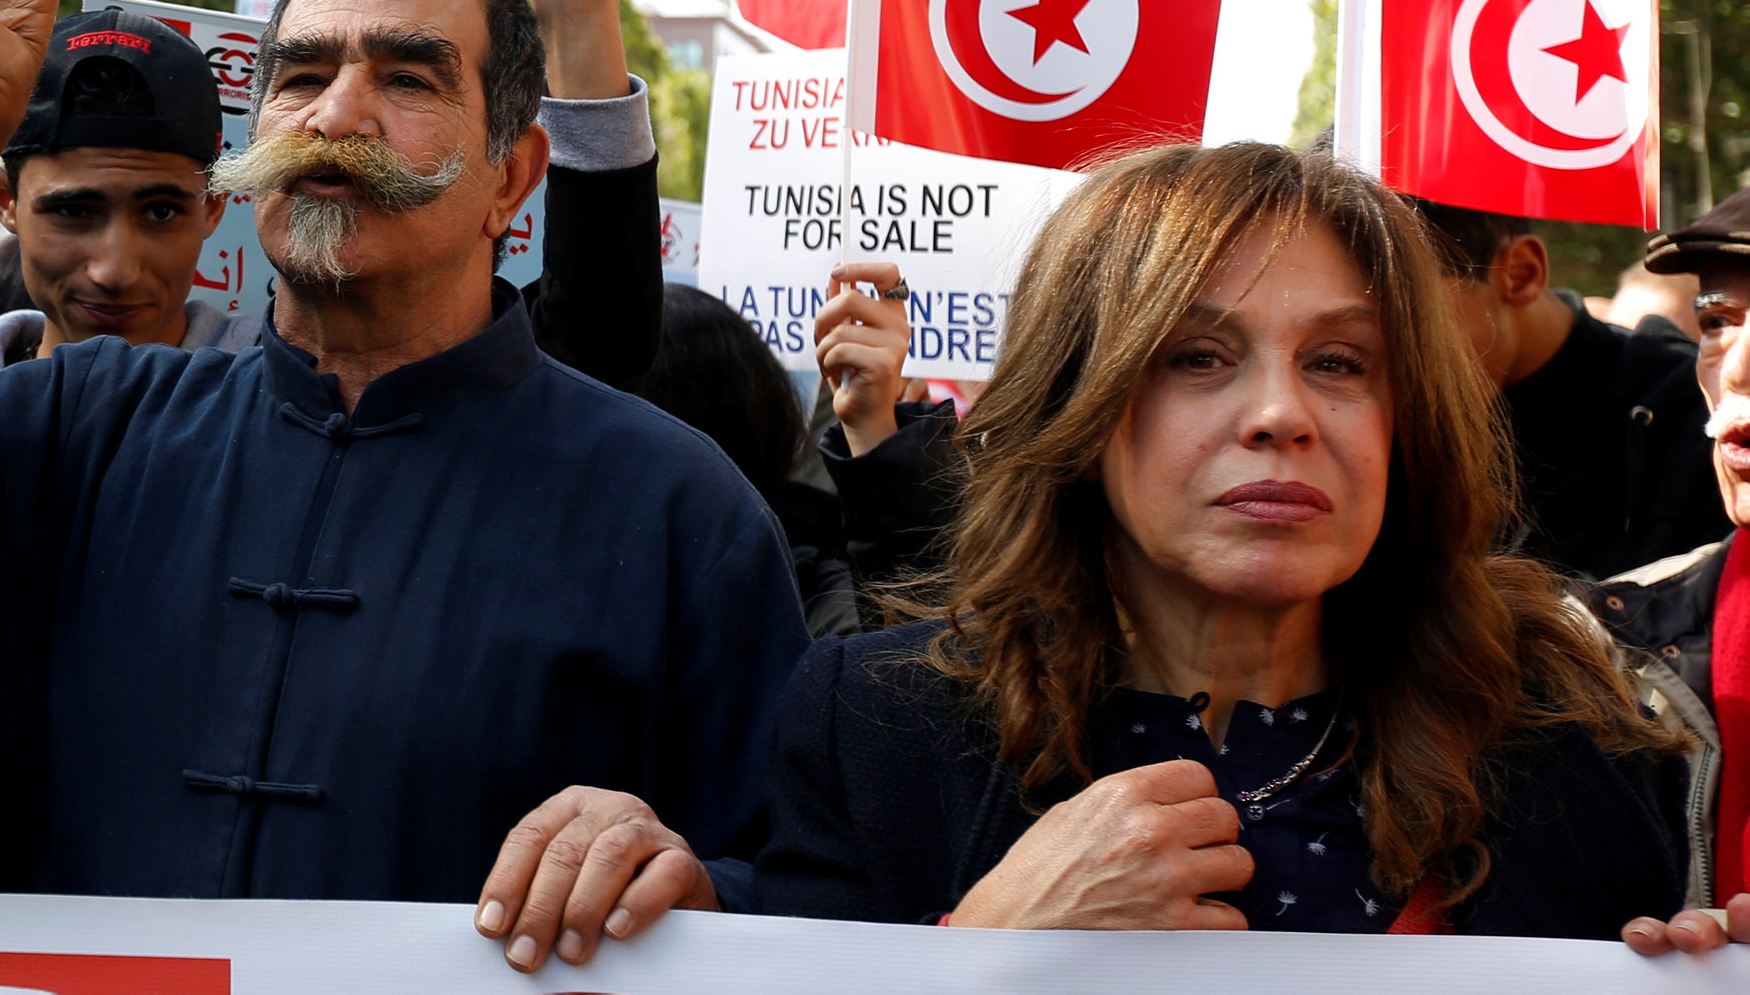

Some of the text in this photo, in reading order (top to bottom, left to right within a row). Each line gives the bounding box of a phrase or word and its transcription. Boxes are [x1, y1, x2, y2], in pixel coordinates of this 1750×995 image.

[66, 30, 152, 54] Ferrari
[217, 87, 252, 101] RRORIS
[732, 76, 844, 112] TUNISIA
[750, 118, 790, 150] ZU
[745, 184, 999, 218] TUNISIA IS NOT
[784, 219, 954, 253] FOR SALE
[908, 326, 996, 363] DRE
